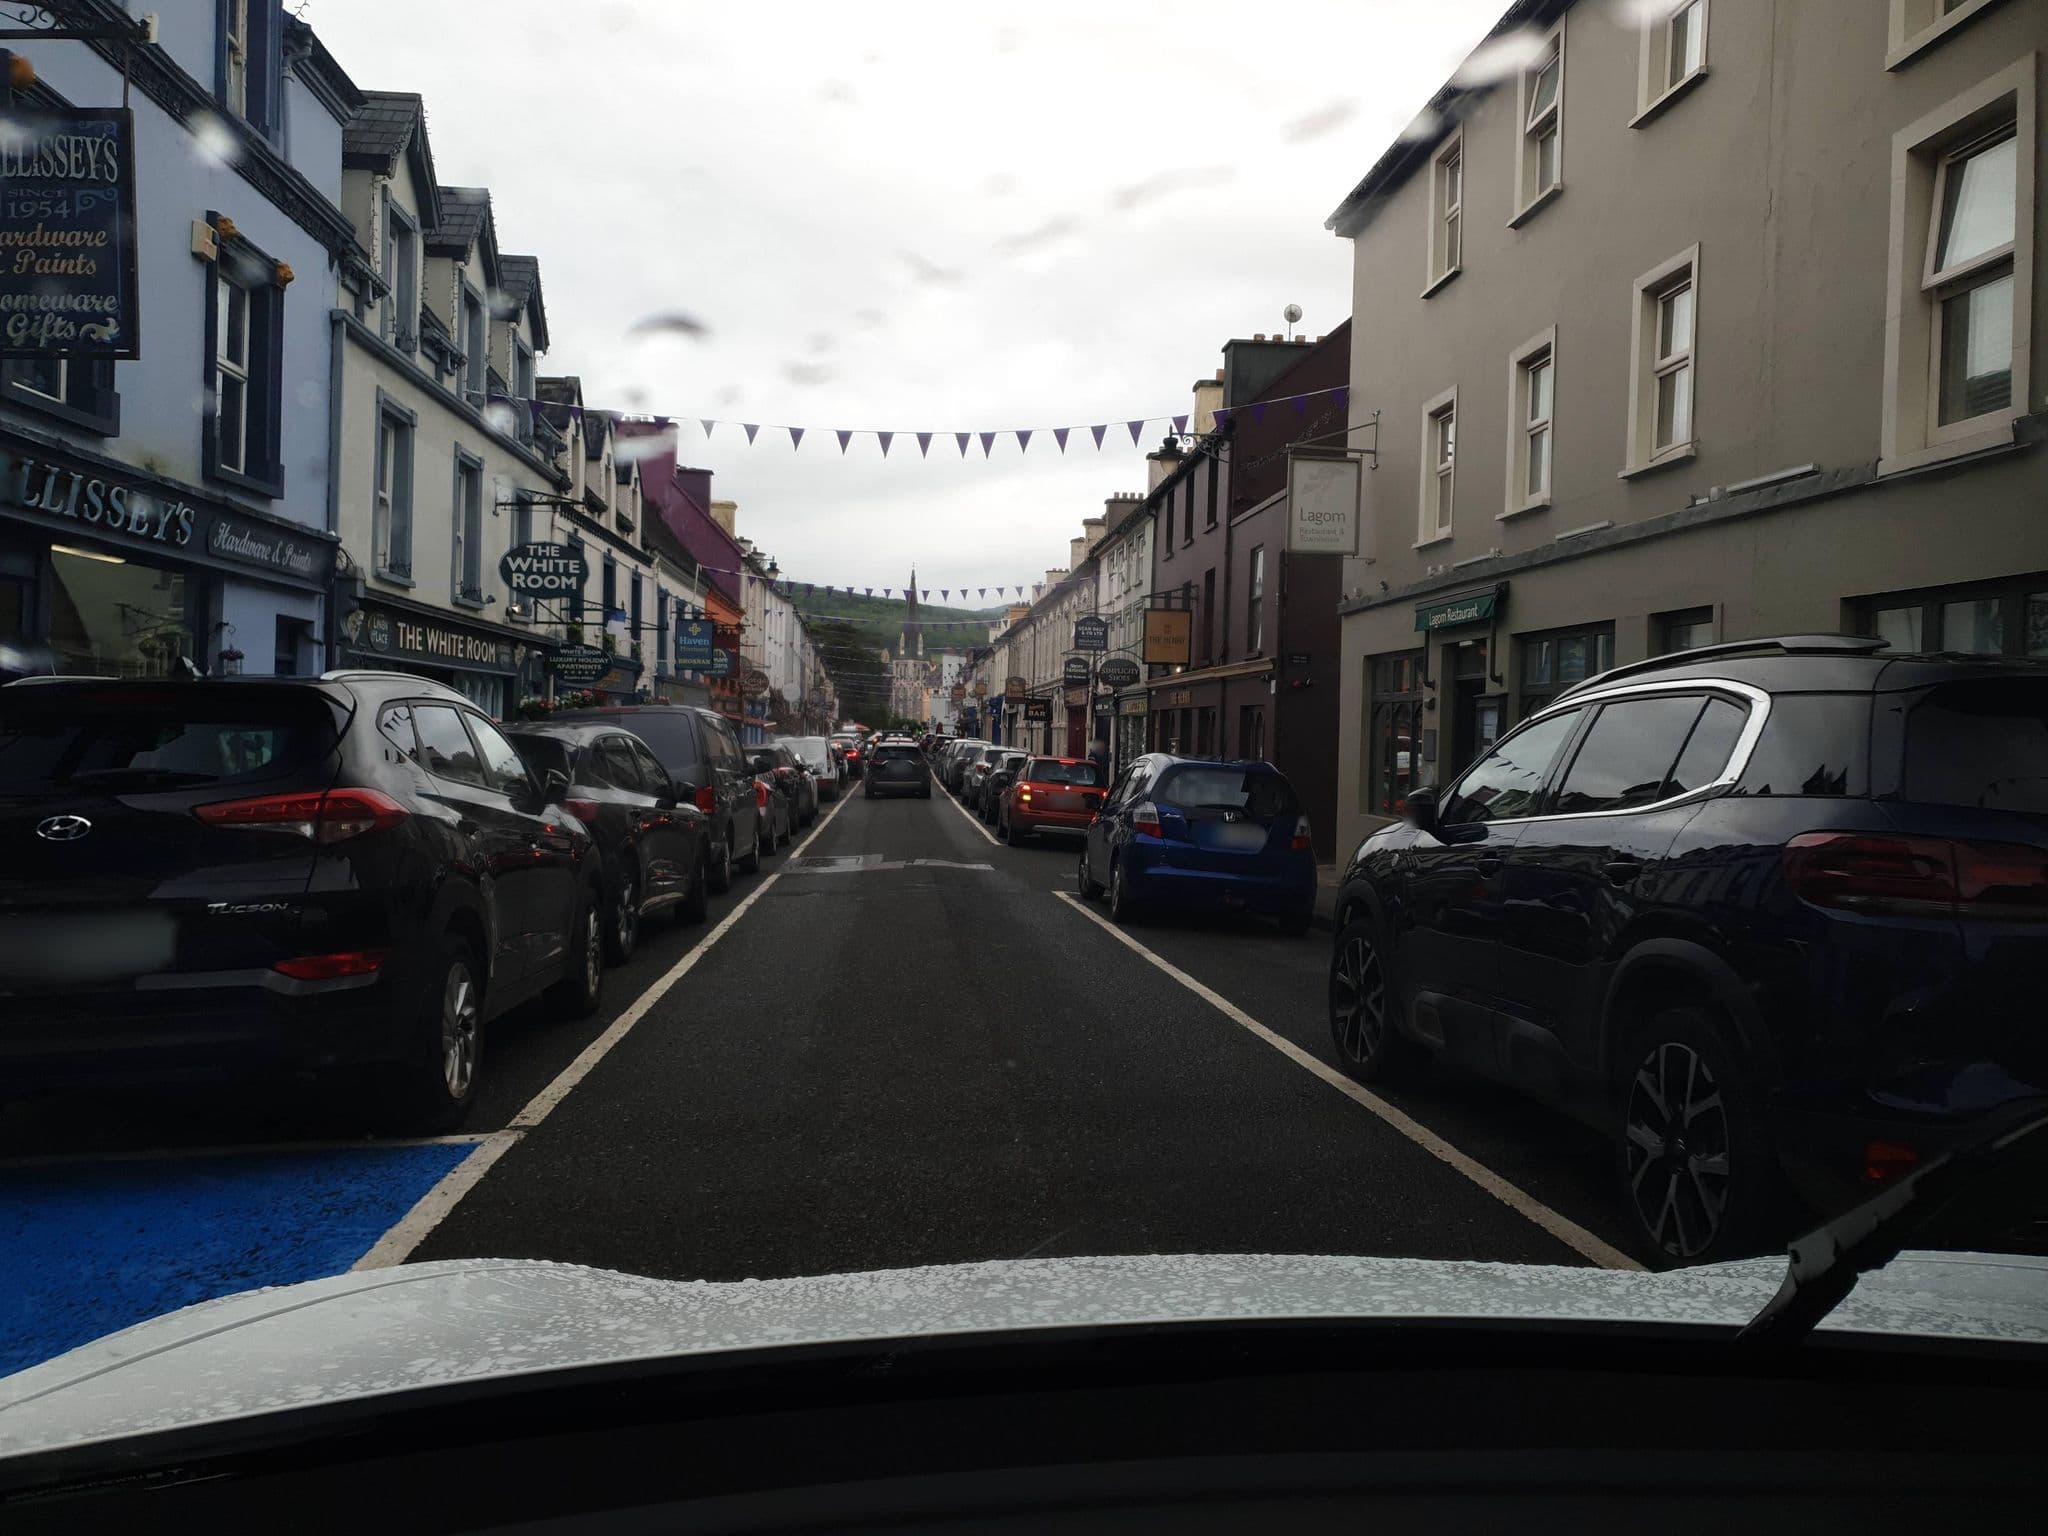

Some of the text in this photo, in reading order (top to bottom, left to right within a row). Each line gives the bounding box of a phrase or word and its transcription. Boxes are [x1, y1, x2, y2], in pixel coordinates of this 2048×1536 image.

[8, 189, 66, 198] SINCE
[8, 199, 70, 219] 1954
[13, 249, 97, 275] Paints
[7, 313, 76, 348] Gifts
[1299, 507, 1346, 525] Lagom
[213, 522, 271, 561] Hardware
[282, 543, 312, 572] Paints
[526, 545, 560, 557] THE
[507, 556, 580, 573] WHITE
[512, 572, 577, 590] ROOM
[1429, 602, 1478, 628] Lagom Restaurant
[397, 622, 496, 663] THE WHITE ROOM
[679, 636, 709, 645] Haven
[1101, 667, 1139, 675] SIMPLICITY
[207, 902, 288, 914] TUCSON
